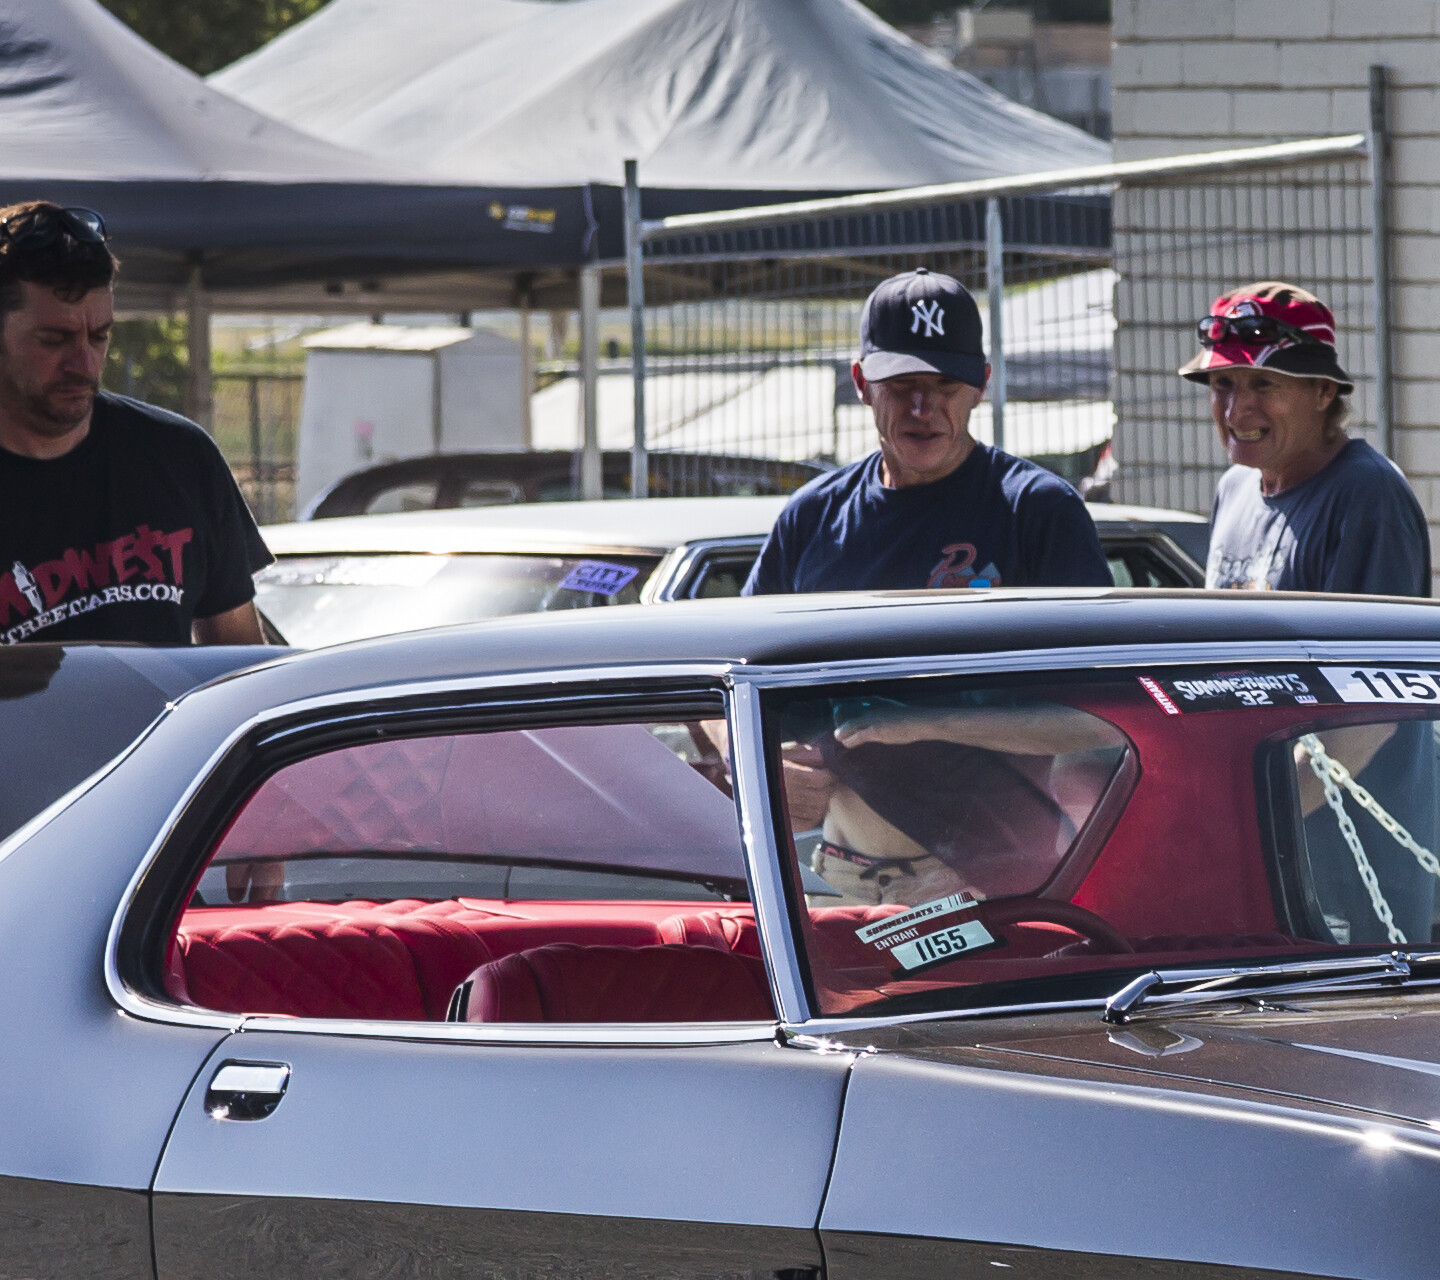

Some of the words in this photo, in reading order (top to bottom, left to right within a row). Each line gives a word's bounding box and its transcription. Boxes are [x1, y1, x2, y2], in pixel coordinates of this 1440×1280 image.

[1173, 673, 1310, 701] SUMMERNATS
[1234, 690, 1274, 707] 32
[874, 927, 920, 951] ENTRANT
[915, 928, 968, 962] 1155
